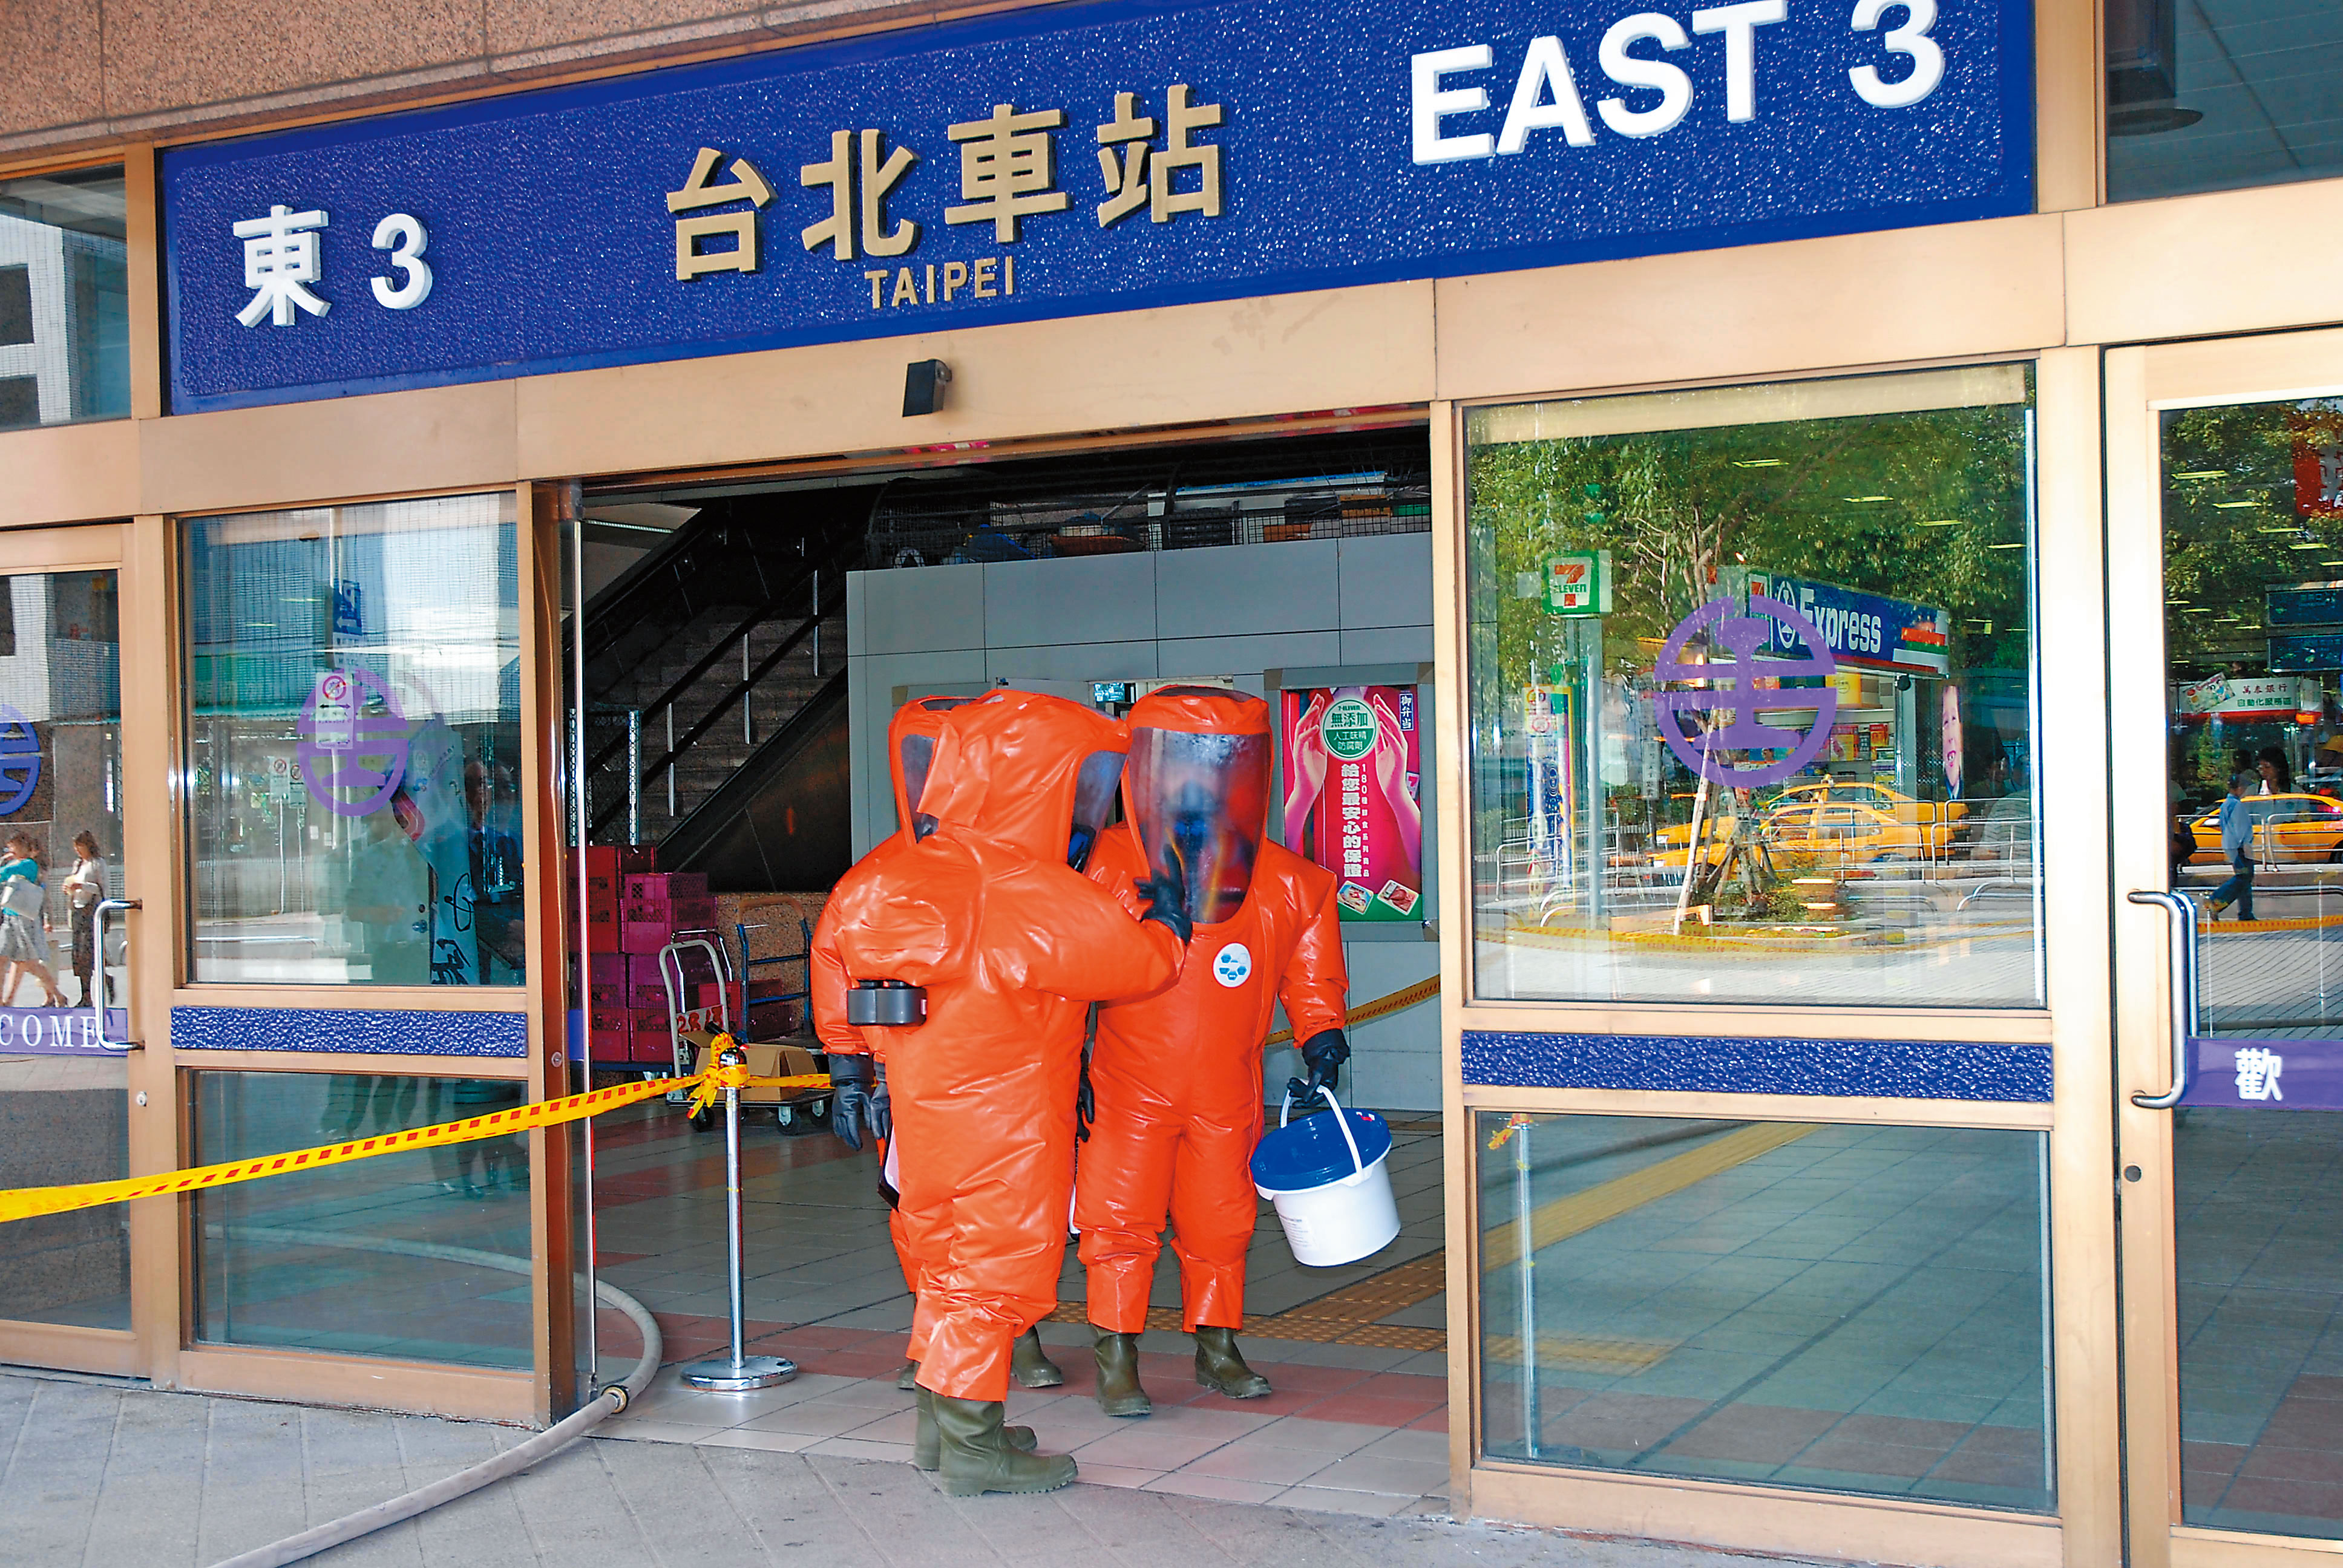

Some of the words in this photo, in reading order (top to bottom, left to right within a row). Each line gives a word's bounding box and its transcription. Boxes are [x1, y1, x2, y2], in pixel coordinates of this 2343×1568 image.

[1411, 0, 1787, 165] EAST
[1848, 0, 1945, 108] 3
[666, 83, 1222, 281] 台北車站
[234, 205, 332, 327] 東
[371, 213, 433, 309] 3
[865, 255, 1014, 309] TAIPEI
[1799, 587, 1881, 653] Express
[1331, 711, 1368, 727] 無添加
[2235, 1048, 2282, 1101] 歡
